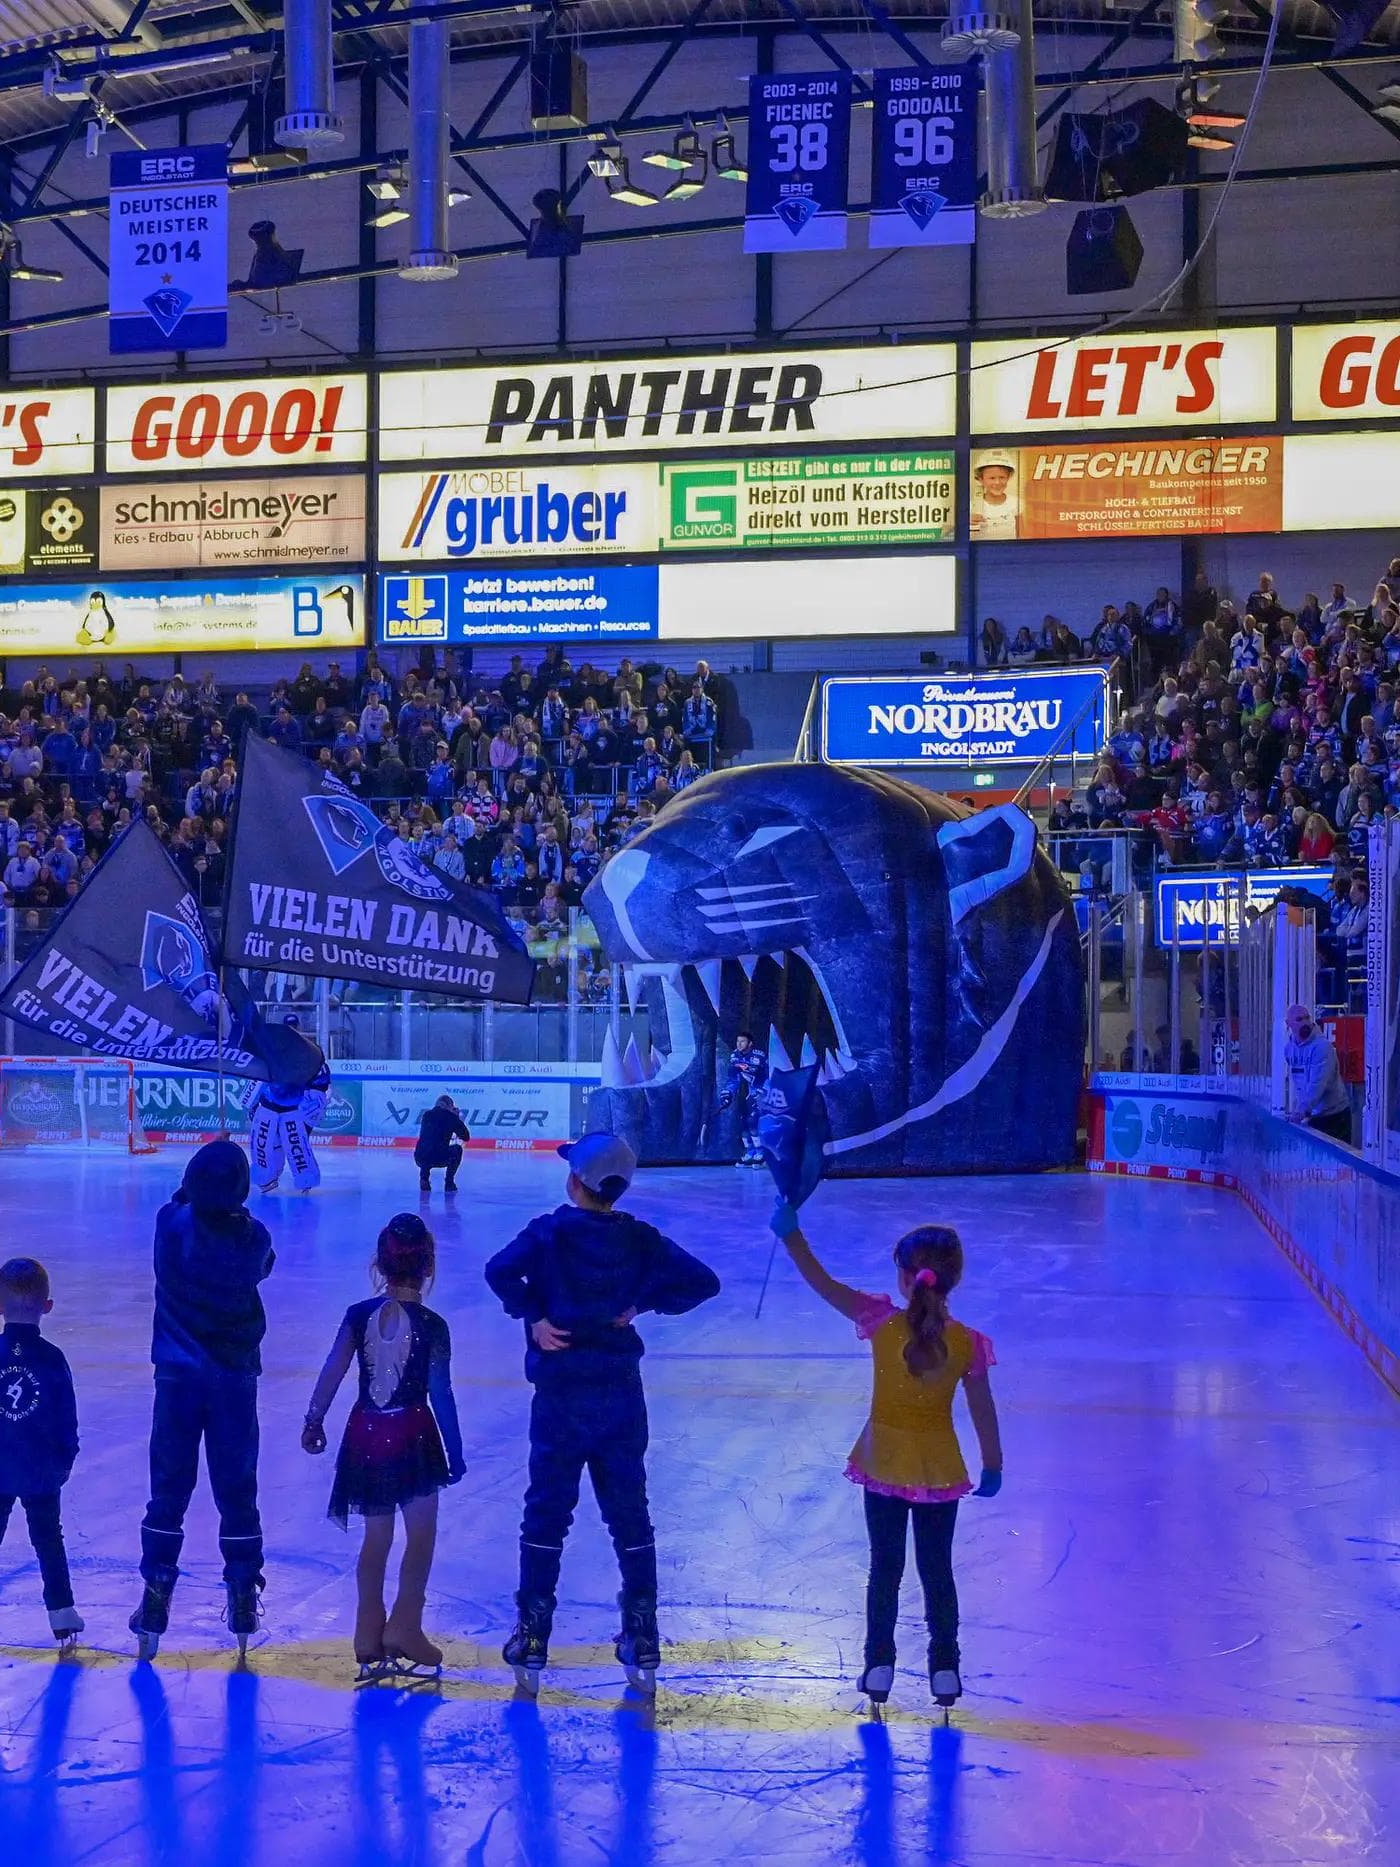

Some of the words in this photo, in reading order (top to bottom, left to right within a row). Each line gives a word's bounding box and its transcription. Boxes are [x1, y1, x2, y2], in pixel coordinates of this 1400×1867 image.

[766, 102, 834, 122] FICENEC
[887, 96, 963, 117] GOODALL
[769, 123, 829, 172] 38
[894, 117, 955, 167] 96
[140, 156, 195, 175] ERC
[780, 183, 814, 194] ERC
[905, 177, 940, 188] ERC
[119, 194, 218, 215] DEUTSCHER
[128, 216, 209, 236] MEISTER
[135, 240, 202, 266] 2014
[1026, 341, 1224, 419] LET'S
[484, 363, 822, 444] PANTHER
[130, 386, 344, 461] GOOO!
[748, 460, 802, 477] EISZEIT
[805, 460, 830, 477] gibt
[832, 462, 847, 474] es
[851, 461, 872, 473] nur
[890, 458, 911, 472] der
[915, 458, 951, 471] Arena
[1032, 446, 1271, 481] HECHINGER
[749, 485, 805, 505] Heizöl
[813, 484, 846, 502] und
[852, 480, 950, 501] Kraftstoffe
[1149, 478, 1222, 490] Baukompetenz
[1224, 477, 1243, 487] seit
[1245, 476, 1267, 486] 1950
[115, 491, 337, 530] schmidmeyer
[1150, 496, 1196, 507] TIEFBAU
[446, 483, 626, 557] gruber
[749, 510, 802, 529] direkt
[811, 511, 849, 526] vom
[857, 506, 950, 525] Hersteller
[1059, 509, 1130, 521] ENTSORGUNG
[1143, 506, 1243, 518] CONTAINERDIENST
[114, 532, 140, 544] Kies
[149, 531, 194, 544] Erdbau
[203, 527, 259, 541] Abbruch
[674, 523, 733, 537] GUNVOR
[40, 544, 84, 554] elements
[463, 578, 501, 594] Jetzt
[506, 576, 595, 593] bewerben!
[463, 596, 607, 614] karriere.bauer.de
[389, 620, 443, 636] BAUER
[538, 622, 592, 634] Maschinen
[599, 620, 650, 631] Resources
[868, 699, 1062, 738] NORDBRÄU
[920, 741, 1016, 756] INGOLSTADT
[249, 882, 378, 940] VIELEN
[386, 904, 499, 959] DANK
[244, 931, 274, 958] für
[280, 937, 315, 963] die
[322, 943, 496, 994] Unterstützung
[35, 948, 174, 1048] VIELEN
[11, 989, 48, 1023] für
[49, 1018, 88, 1045] die
